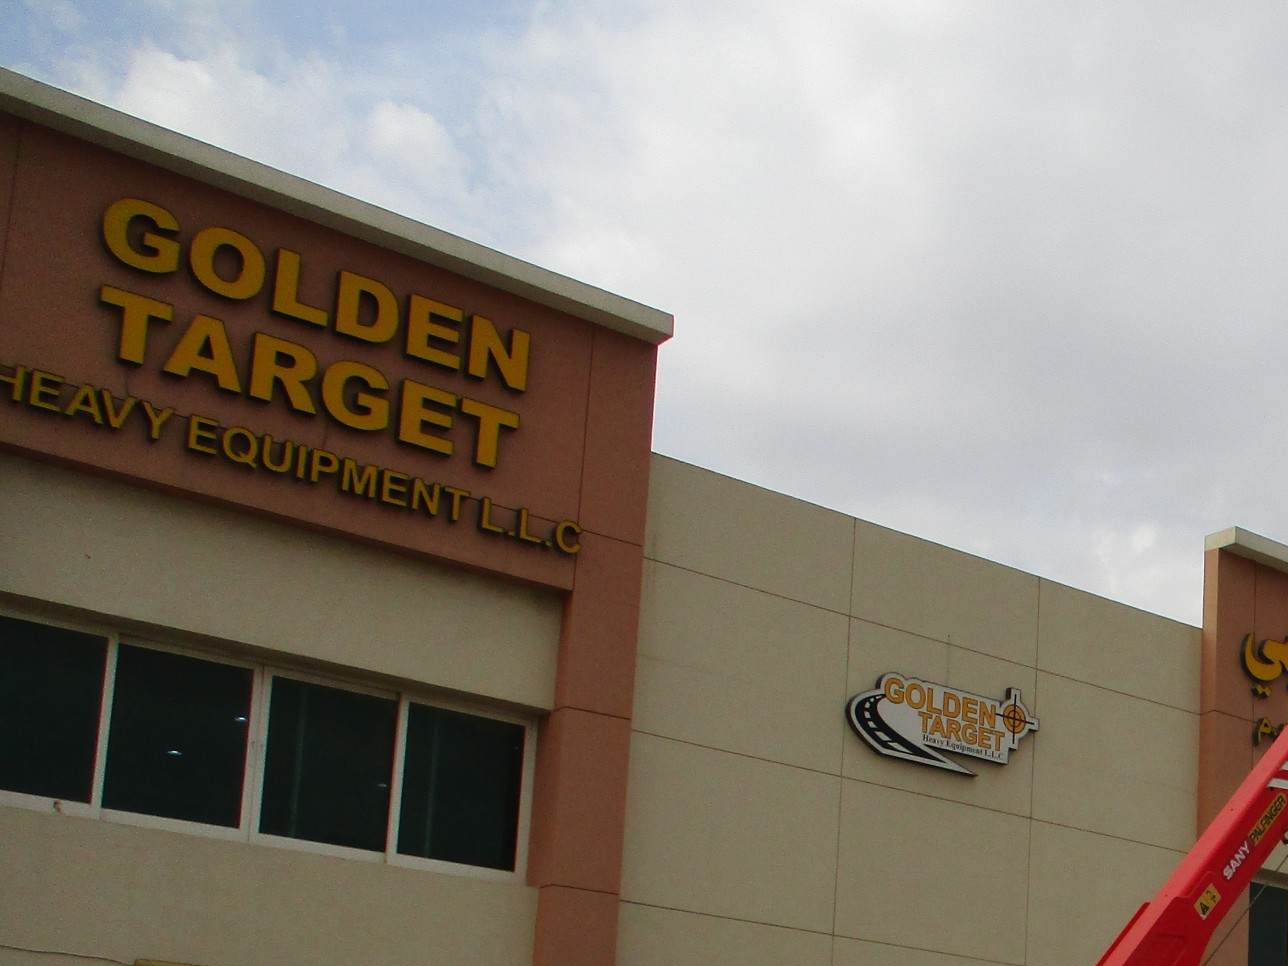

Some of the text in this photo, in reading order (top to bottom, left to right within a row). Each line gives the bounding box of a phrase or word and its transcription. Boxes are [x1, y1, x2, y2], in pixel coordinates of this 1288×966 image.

[104, 199, 531, 392] GOLDEN
[100, 285, 520, 469] TARGET
[0, 364, 582, 554] HEAVY EQUIPMENT L.L.C
[884, 677, 997, 729] GOLDEN
[918, 711, 1006, 752] TARGET
[922, 733, 944, 746] Heavy
[946, 739, 982, 754] Equipment
[1222, 794, 1287, 881] SANY PALFINGER
